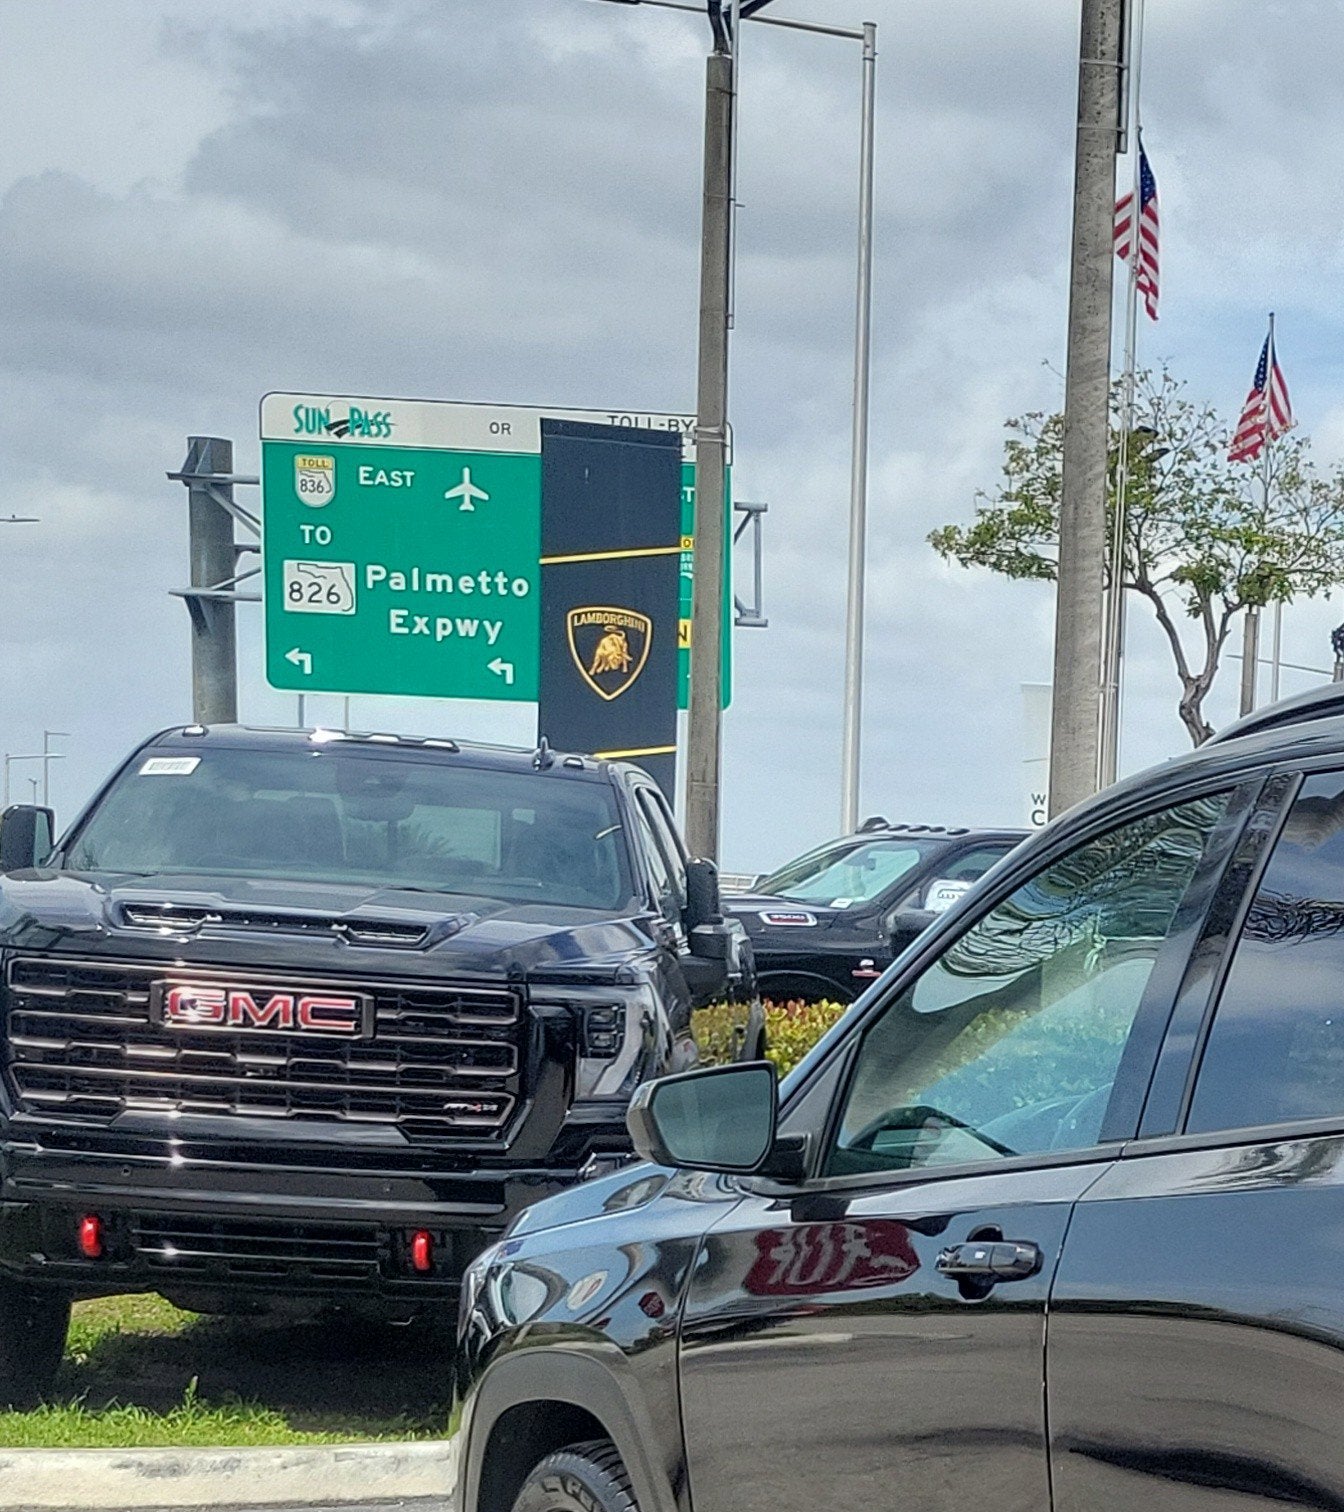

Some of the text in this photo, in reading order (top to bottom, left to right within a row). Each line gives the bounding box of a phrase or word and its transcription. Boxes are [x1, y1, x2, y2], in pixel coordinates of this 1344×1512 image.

[489, 421, 511, 436] OR
[301, 458, 328, 468] TOLL
[300, 478, 325, 494] 836
[359, 466, 415, 488] EAST
[300, 524, 332, 545] TO
[366, 564, 529, 597] Palmetto
[289, 580, 341, 605] 826
[389, 609, 503, 645] Expwy
[573, 612, 645, 633] LAMBORGHINI
[168, 986, 356, 1031] GMC
